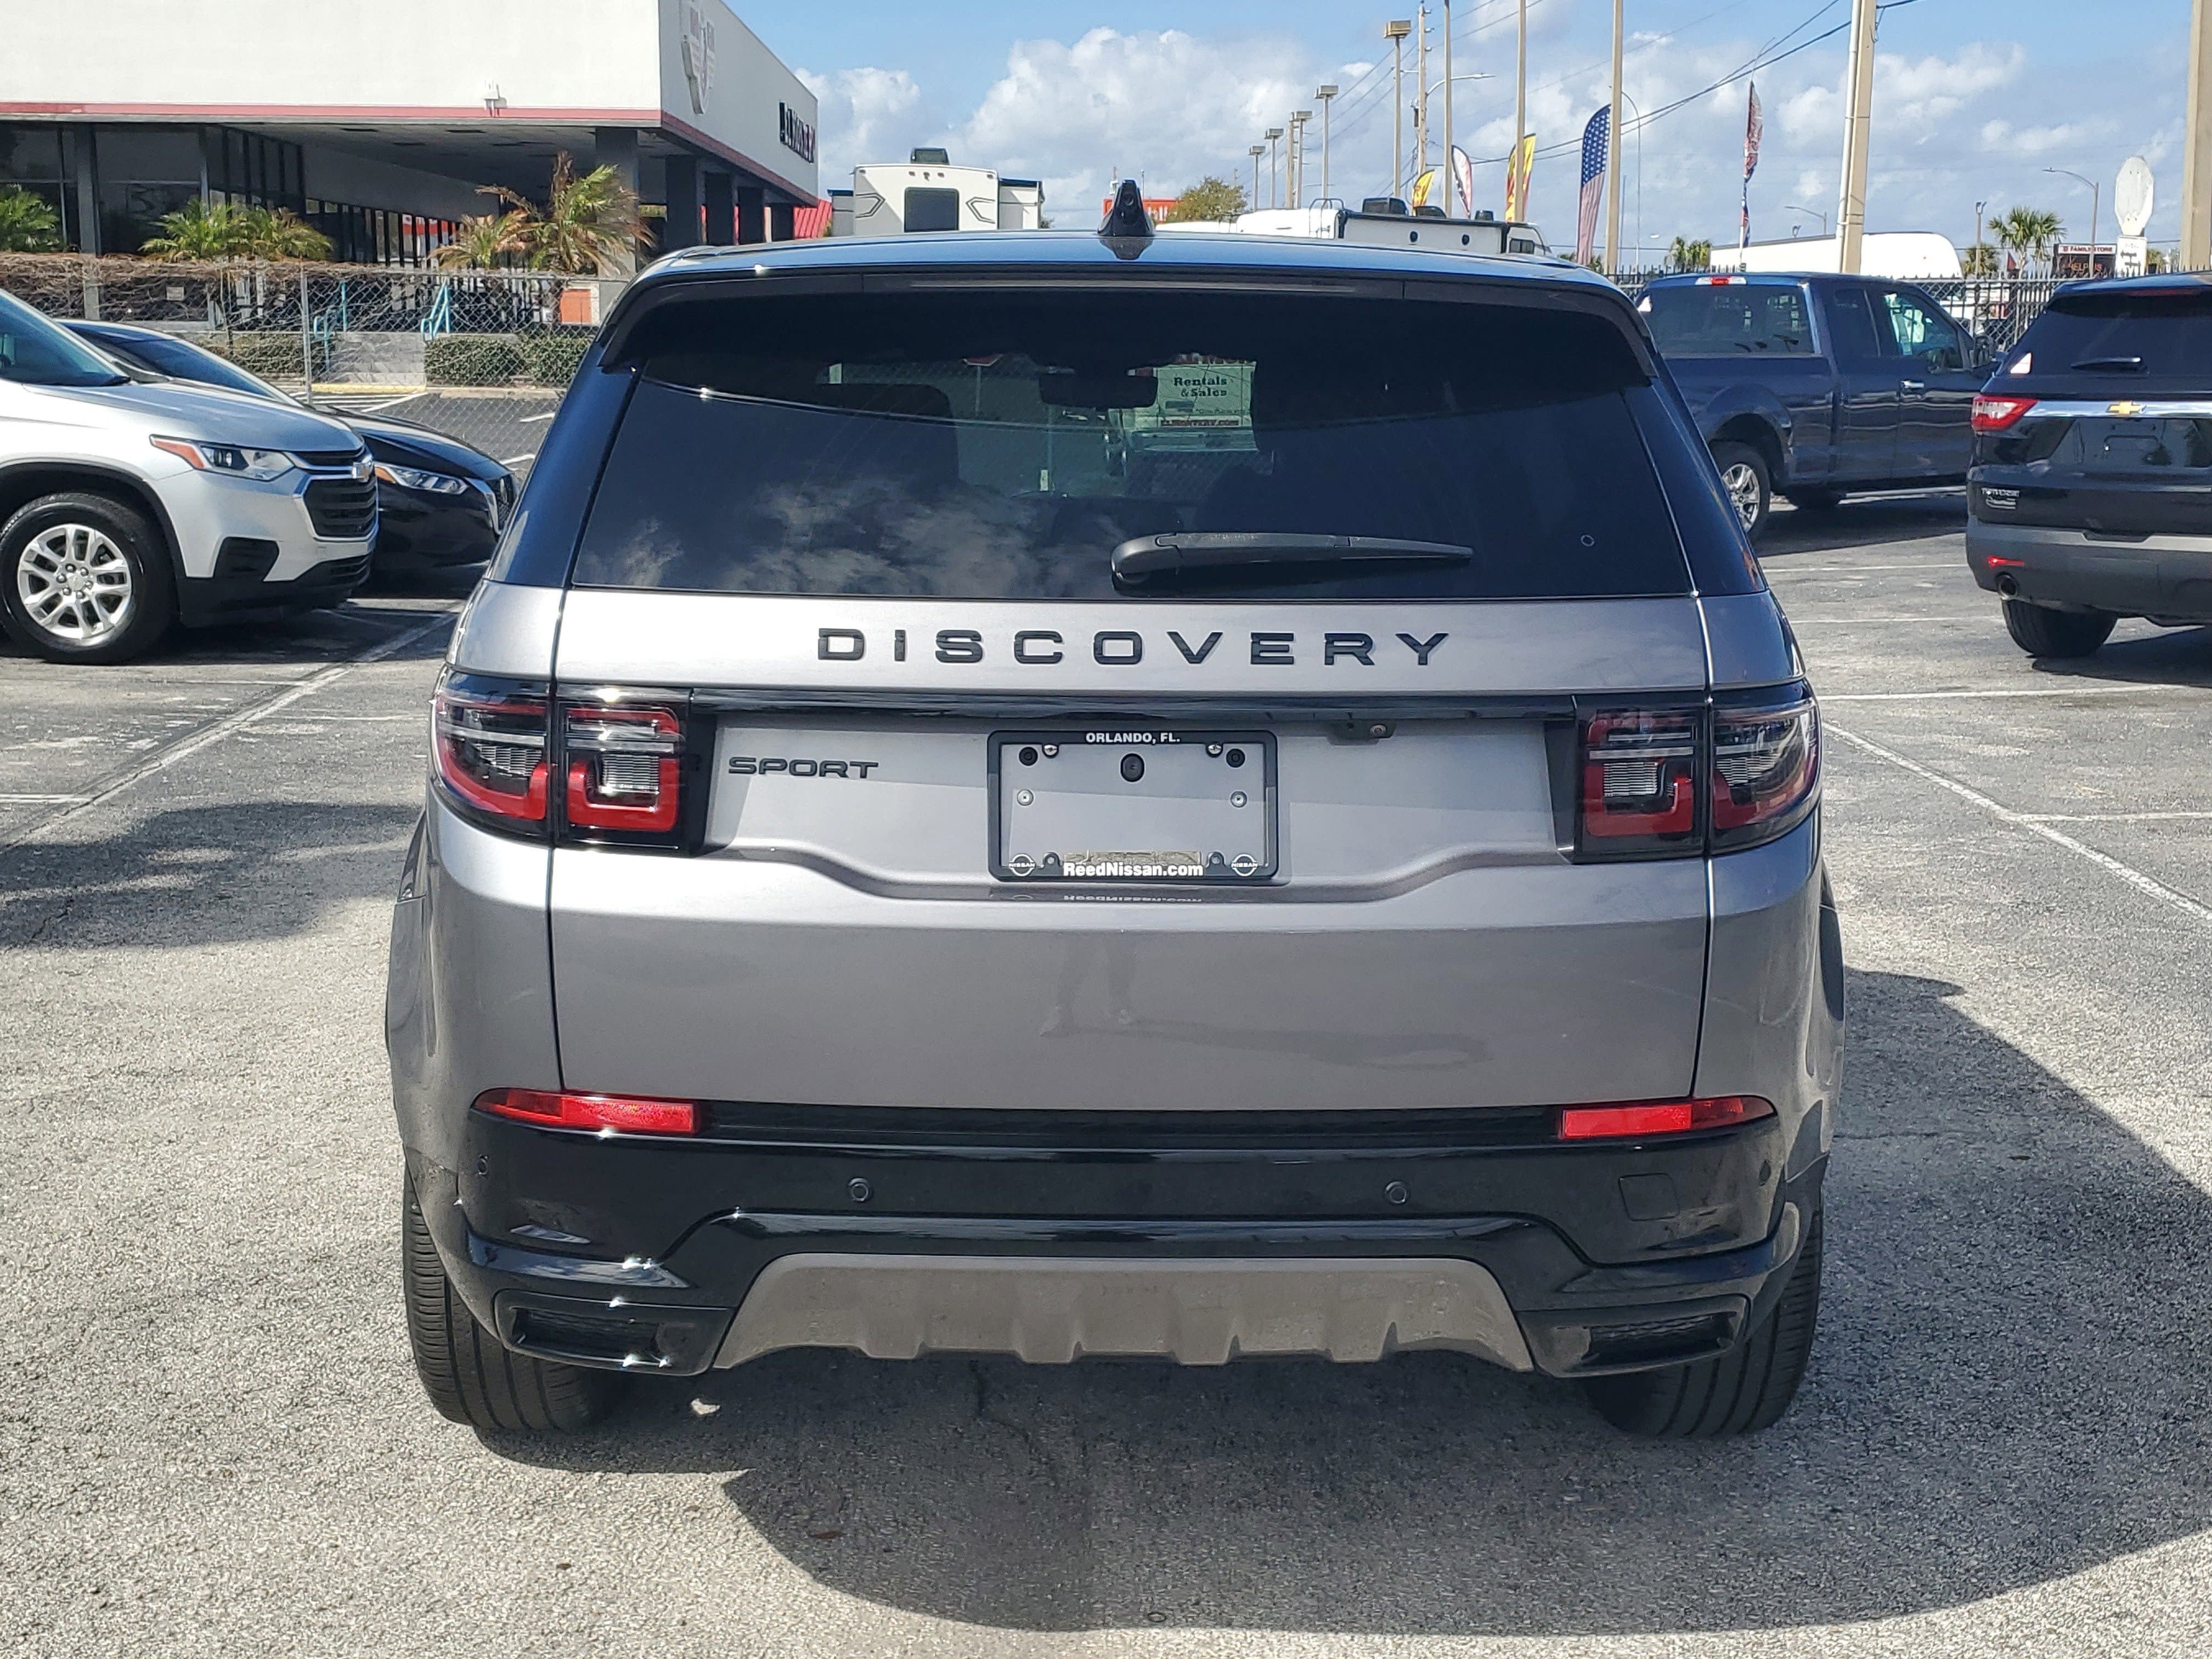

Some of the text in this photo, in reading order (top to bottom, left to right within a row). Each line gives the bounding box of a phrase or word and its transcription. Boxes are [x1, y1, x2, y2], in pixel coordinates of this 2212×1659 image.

[1173, 375, 1227, 386] Rentals
[1190, 387, 1227, 397] Sales
[818, 628, 1449, 665] DISCOVERY
[1086, 732, 1181, 744] ORLANDO, FL.
[729, 757, 879, 778] SPORT
[1063, 862, 1203, 876] ReedNissan.com
